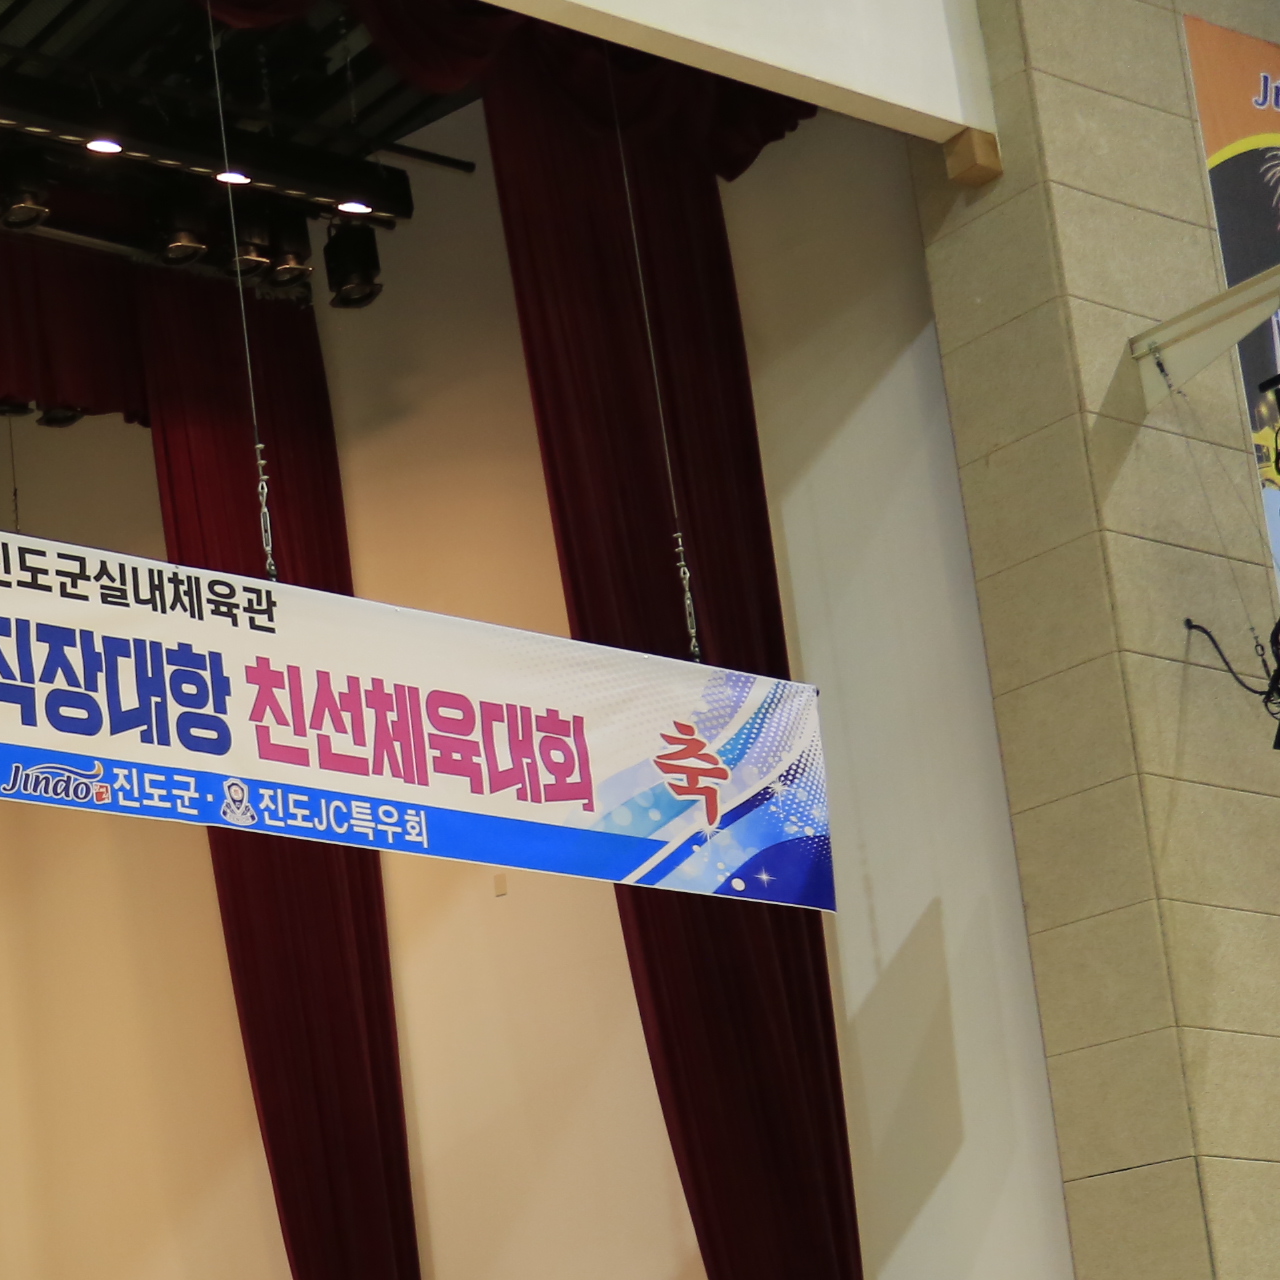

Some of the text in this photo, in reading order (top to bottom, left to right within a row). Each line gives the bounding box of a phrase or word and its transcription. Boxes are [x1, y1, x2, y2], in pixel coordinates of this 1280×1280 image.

[244, 656, 595, 812] 친선체육대회
[652, 721, 730, 827] 축
[1, 763, 92, 802] Jindo
[259, 793, 429, 849] 진도JC특우회
